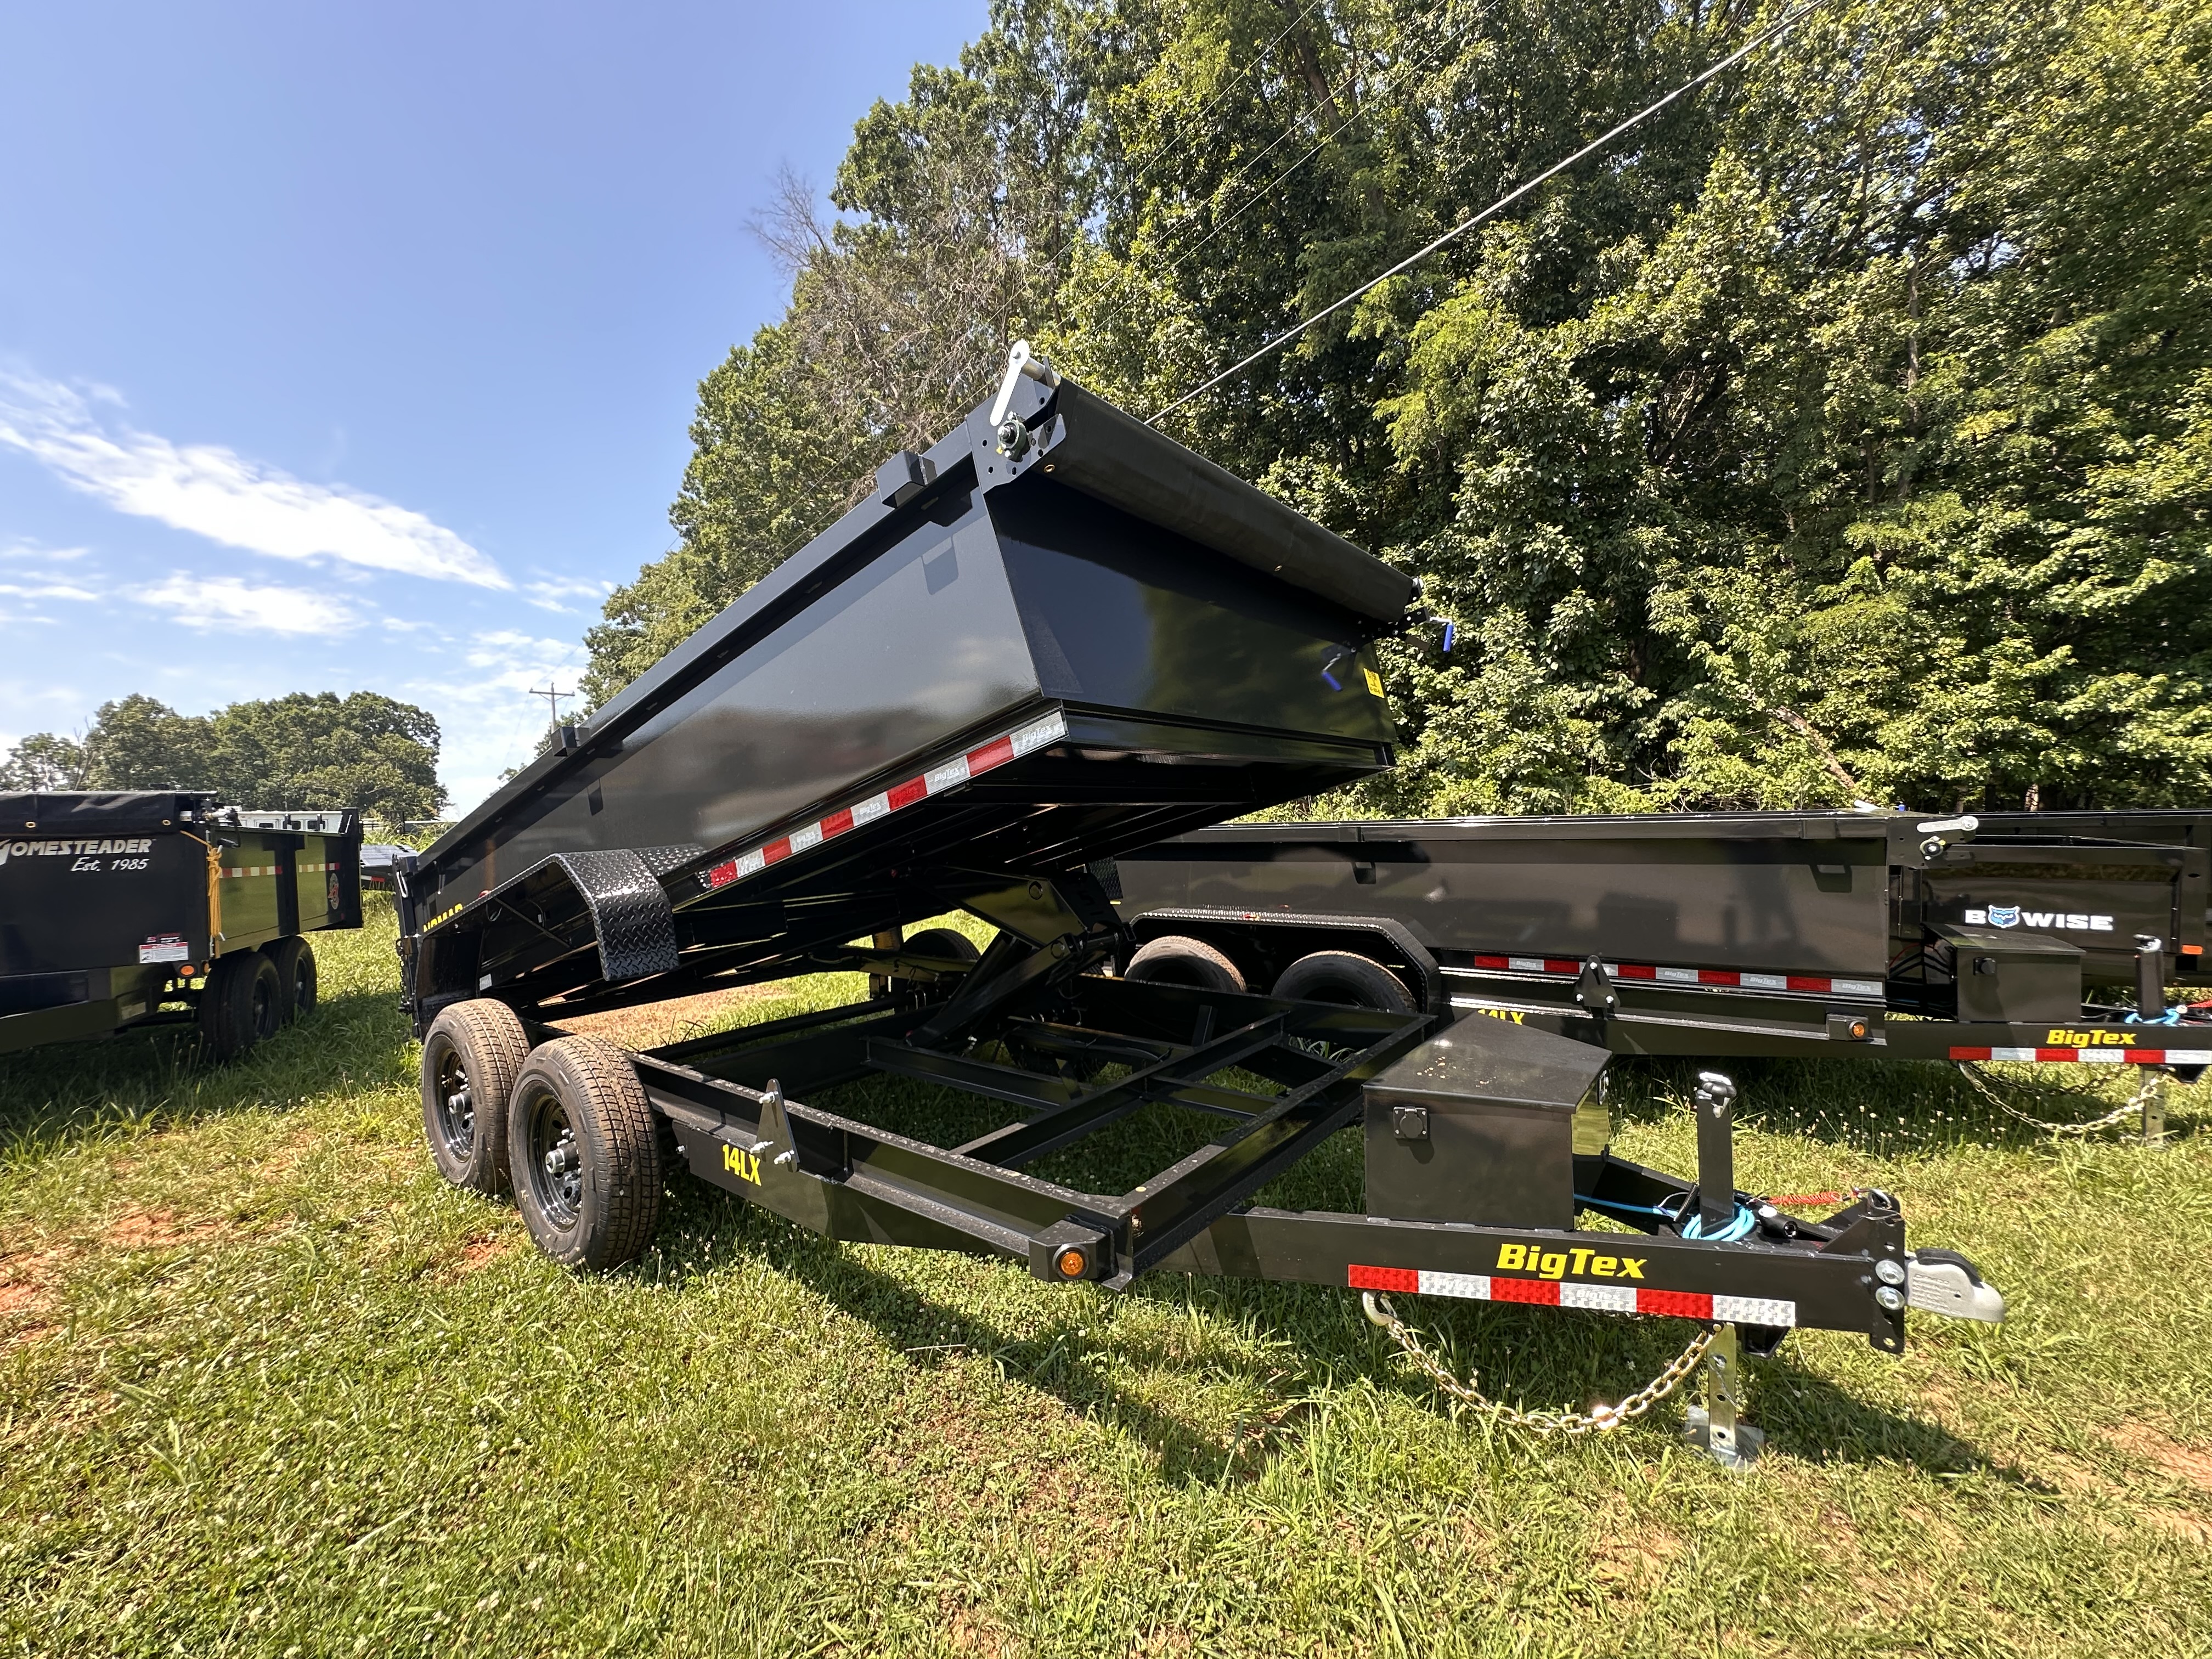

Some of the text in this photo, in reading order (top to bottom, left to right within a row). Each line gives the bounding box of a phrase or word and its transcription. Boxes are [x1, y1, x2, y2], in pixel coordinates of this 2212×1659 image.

[70, 856, 150, 871] Est. 1985
[2046, 1029, 2137, 1048] BigTex
[723, 1144, 762, 1187] 14LX
[1496, 1243, 1647, 1279] BigTex
